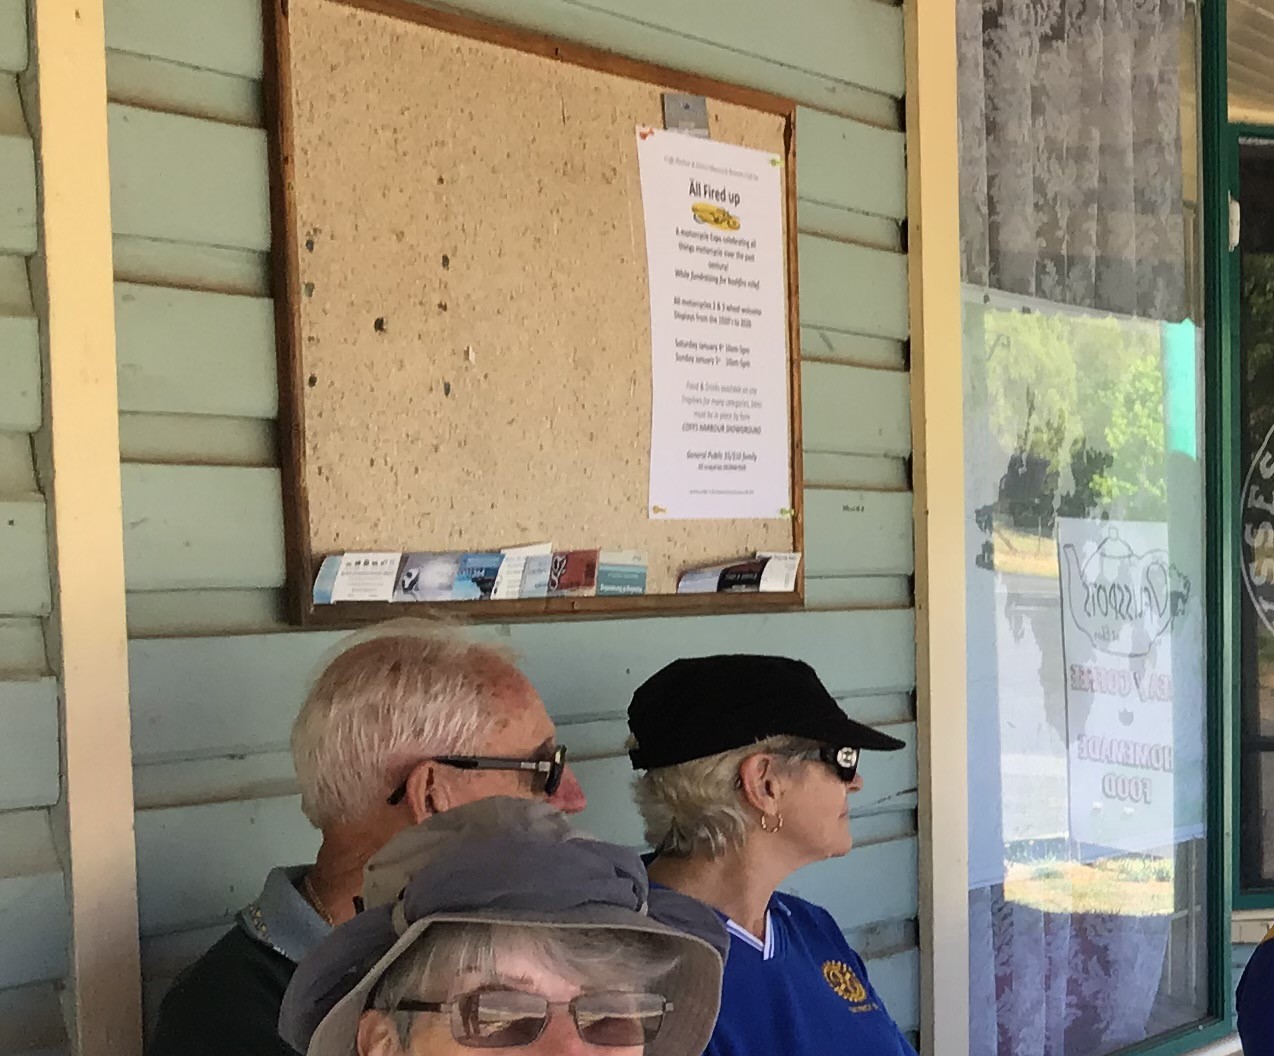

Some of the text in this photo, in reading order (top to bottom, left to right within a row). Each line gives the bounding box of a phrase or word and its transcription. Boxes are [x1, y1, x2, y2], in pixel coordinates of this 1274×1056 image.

[689, 180, 741, 207] All Fired up
